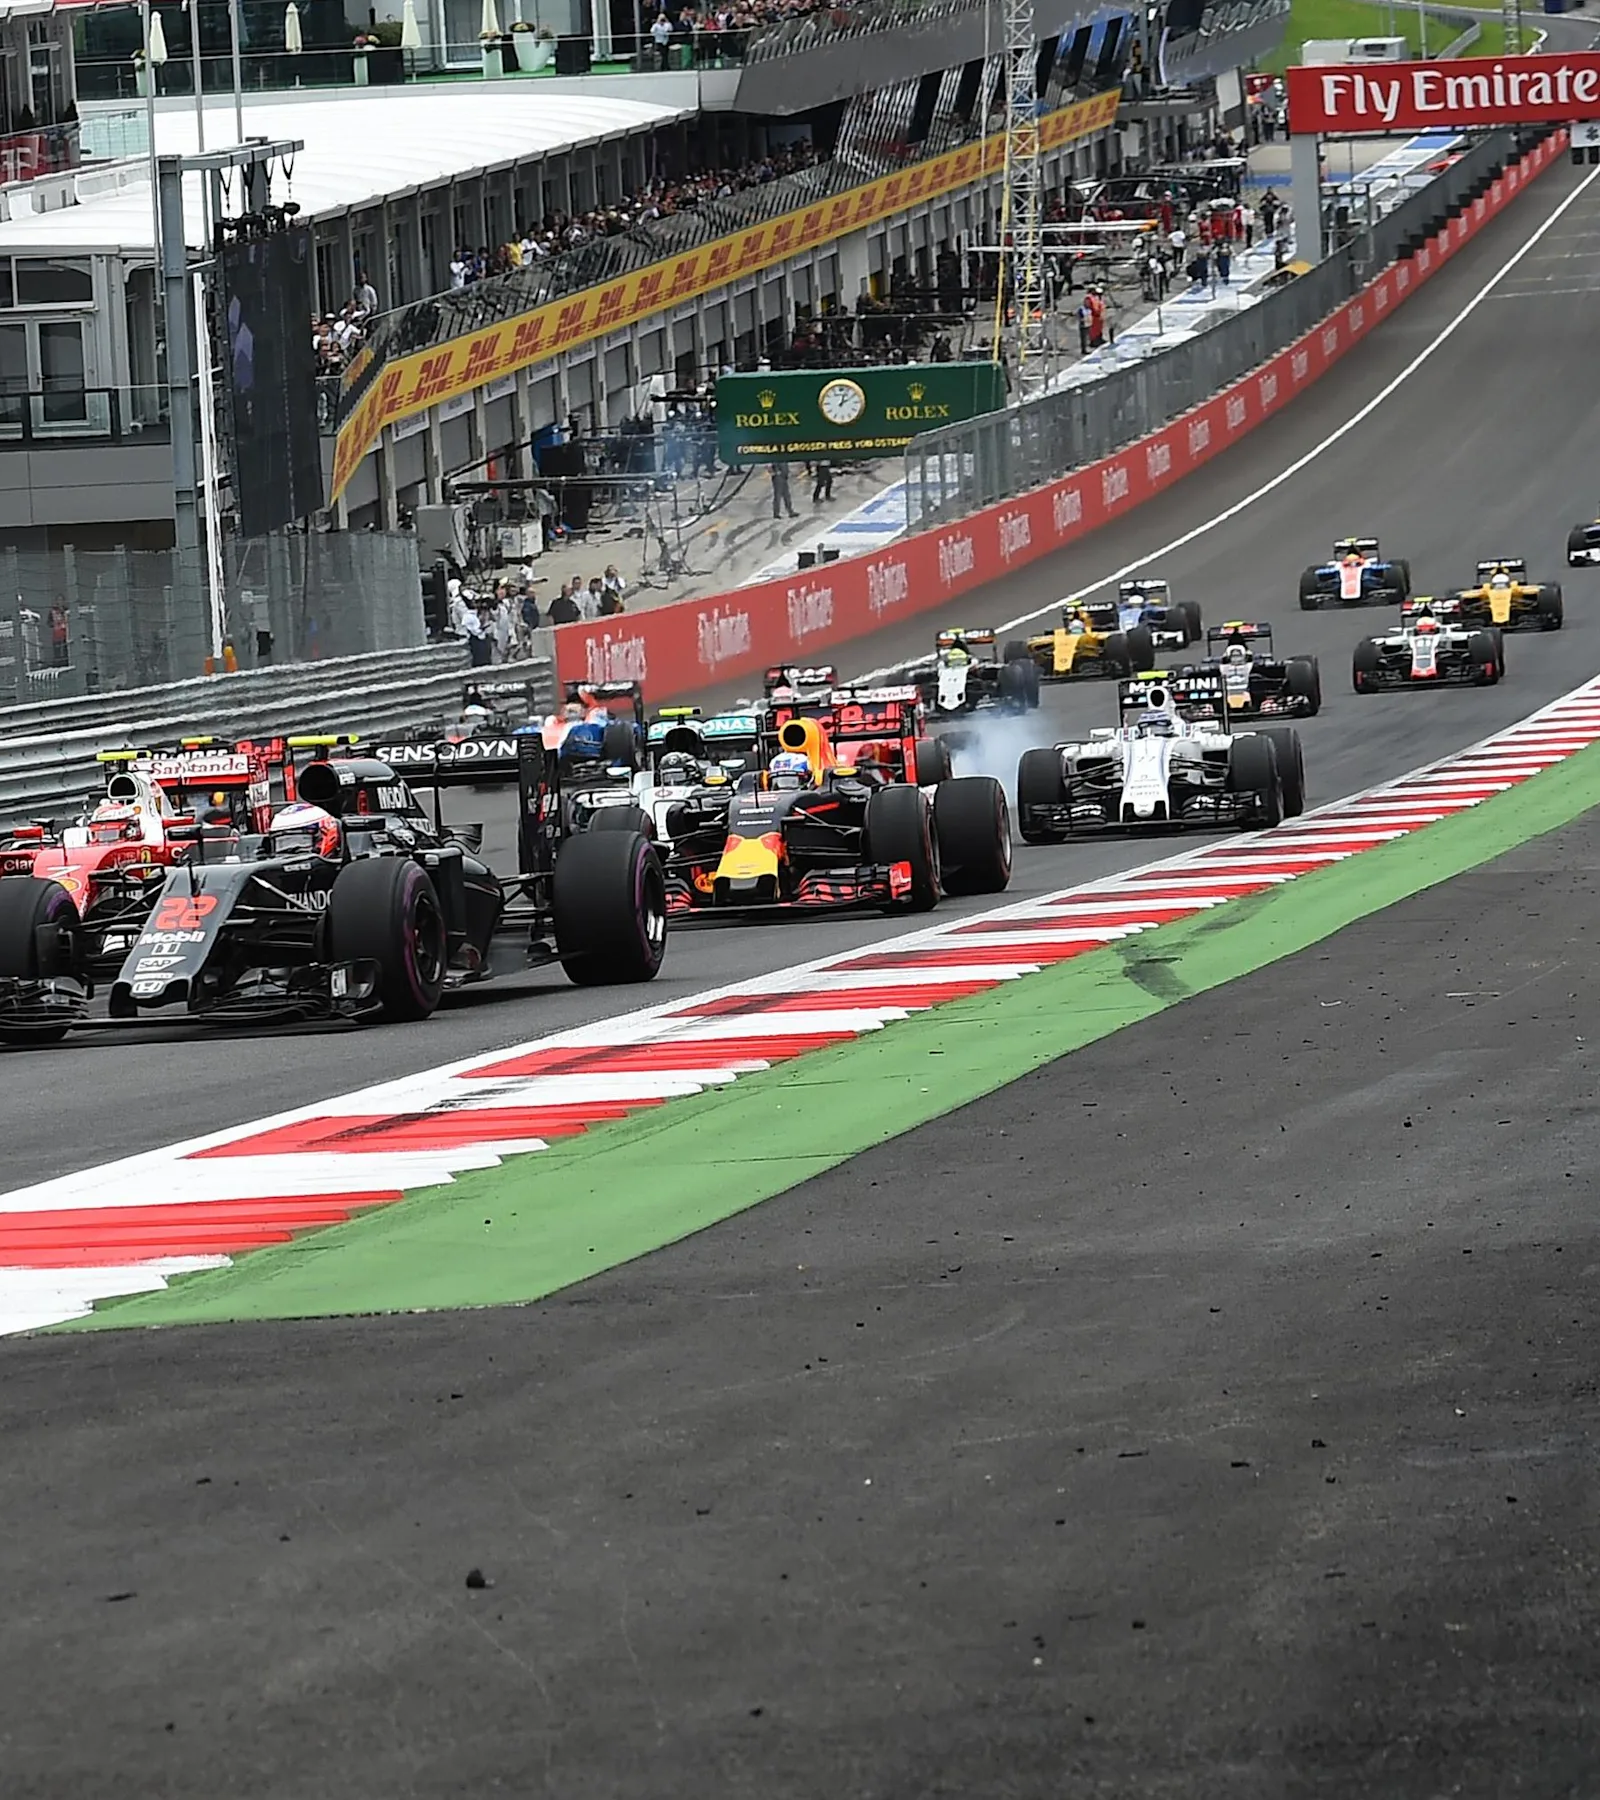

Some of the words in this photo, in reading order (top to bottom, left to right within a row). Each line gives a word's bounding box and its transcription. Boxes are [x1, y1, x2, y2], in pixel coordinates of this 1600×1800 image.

[1321, 74, 1400, 122] Fly
[735, 412, 800, 428] ROLEX
[886, 404, 949, 420] ROLEX
[1129, 677, 1218, 694] MTINI
[840, 702, 900, 733] Bull
[155, 895, 218, 929] 22
[139, 931, 206, 945] Mobil
[139, 959, 172, 969] SAP
